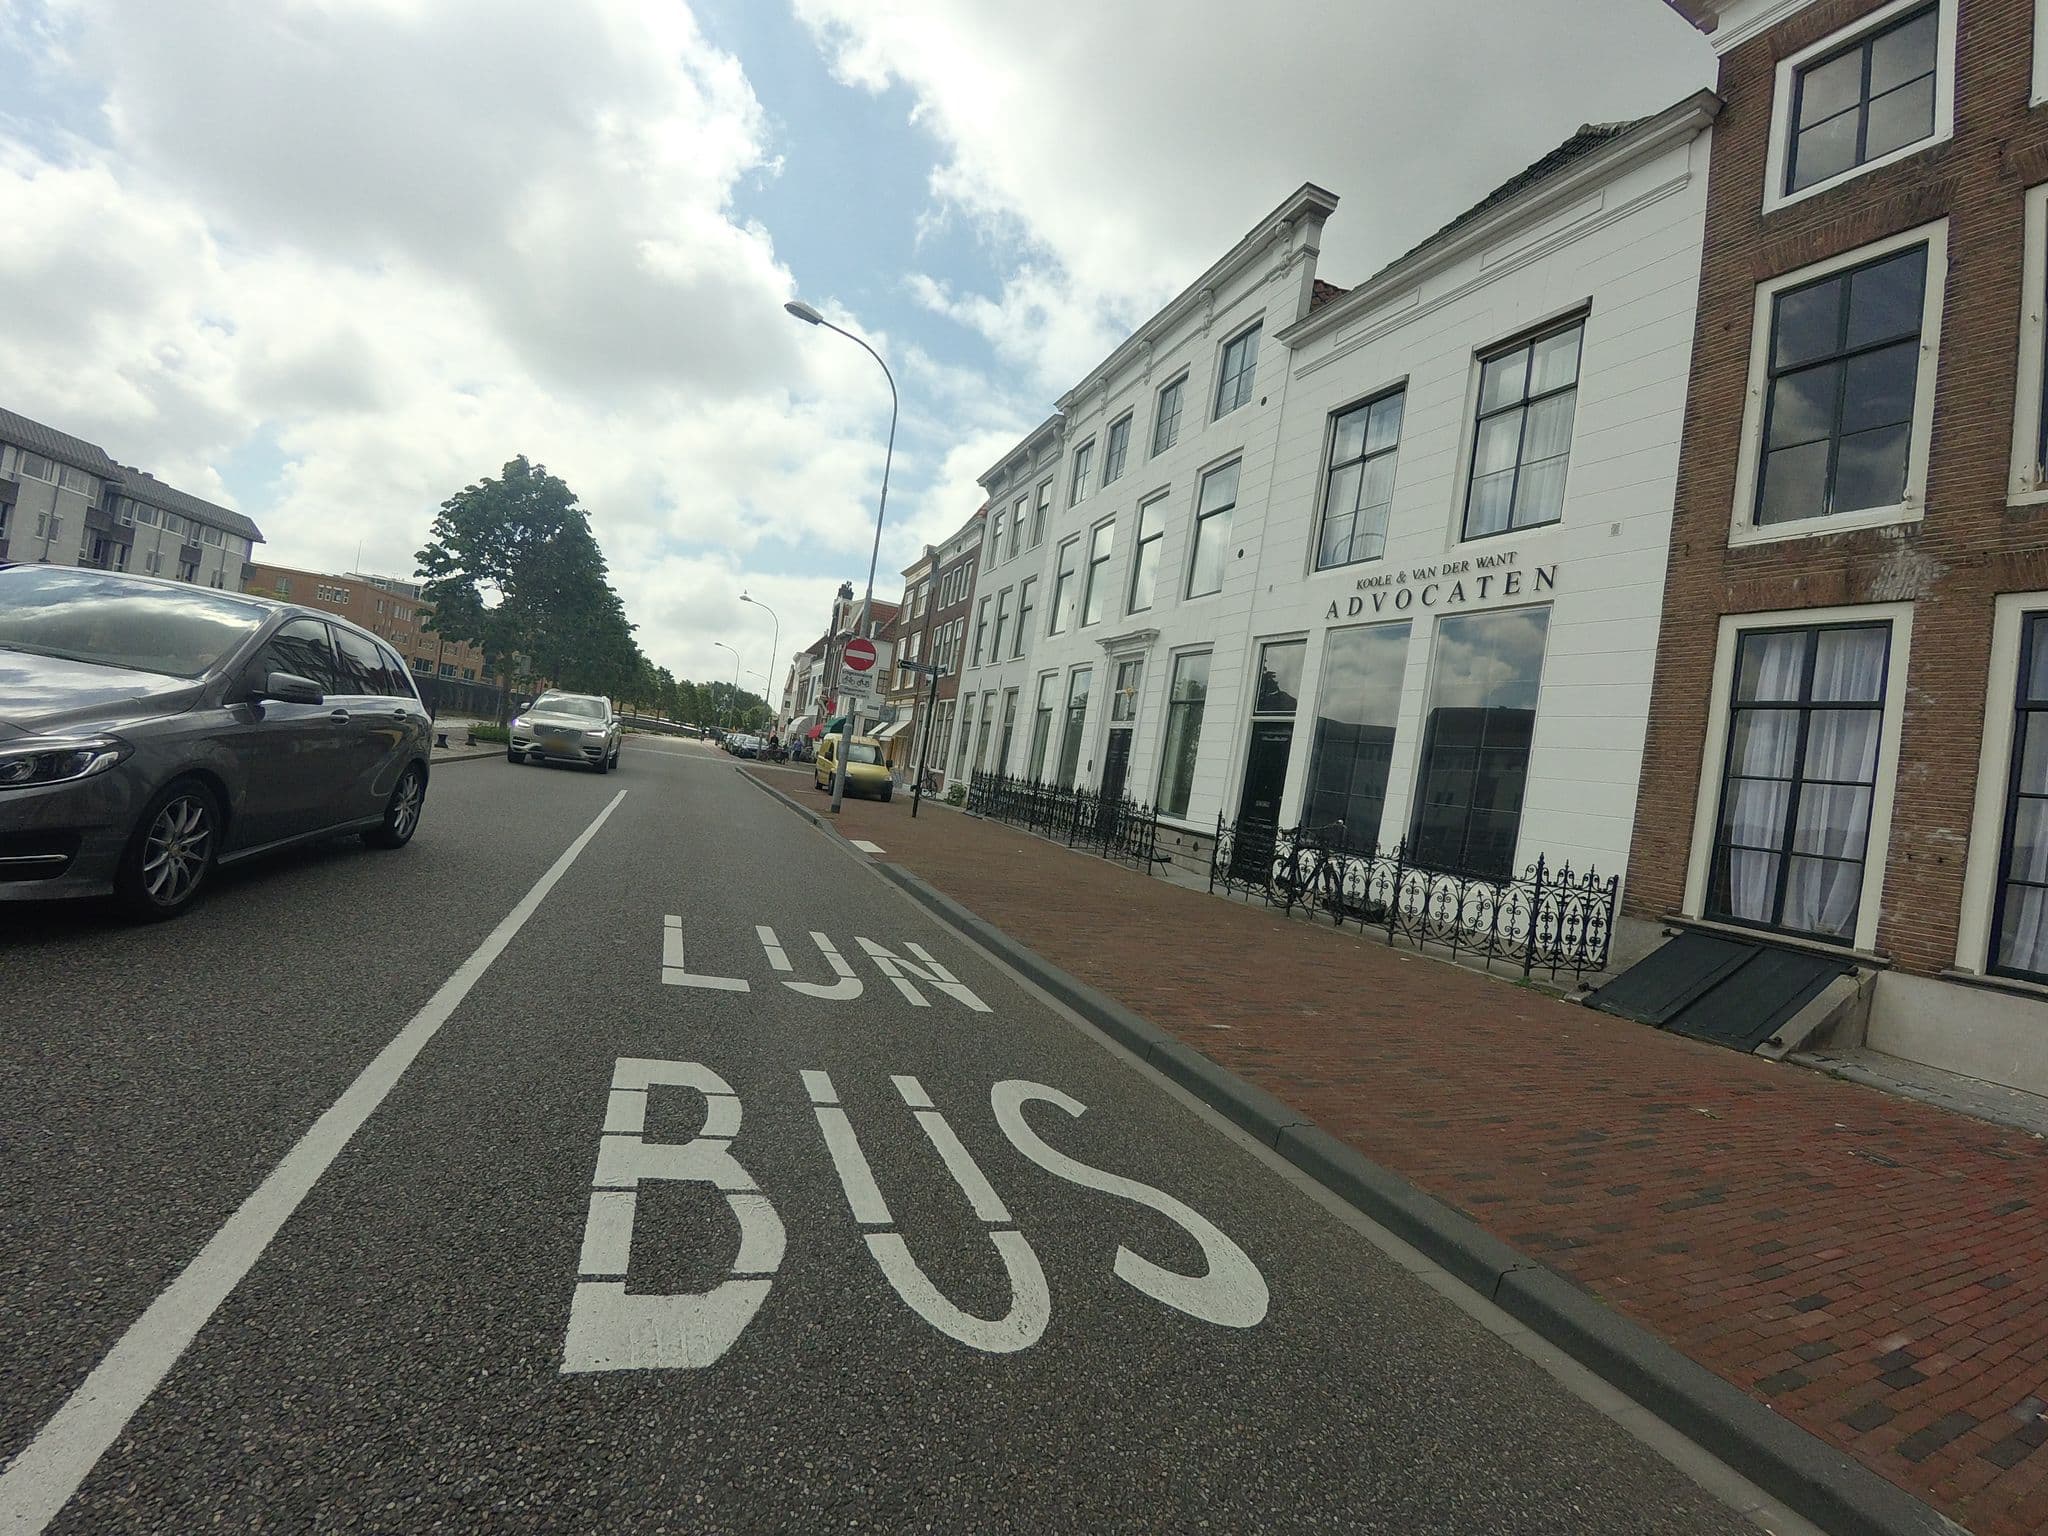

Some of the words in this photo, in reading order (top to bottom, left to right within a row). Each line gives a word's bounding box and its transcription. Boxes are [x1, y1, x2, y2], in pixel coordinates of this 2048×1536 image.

[1325, 564, 1559, 620] ADVOCATEN
[1356, 574, 1393, 590] KOOLE
[1396, 571, 1407, 584] &
[1412, 566, 1438, 580] VAN
[1442, 560, 1470, 576] DER
[1475, 551, 1518, 568] WANT
[661, 914, 994, 1013] LIJN
[559, 1056, 1270, 1374] BUS
